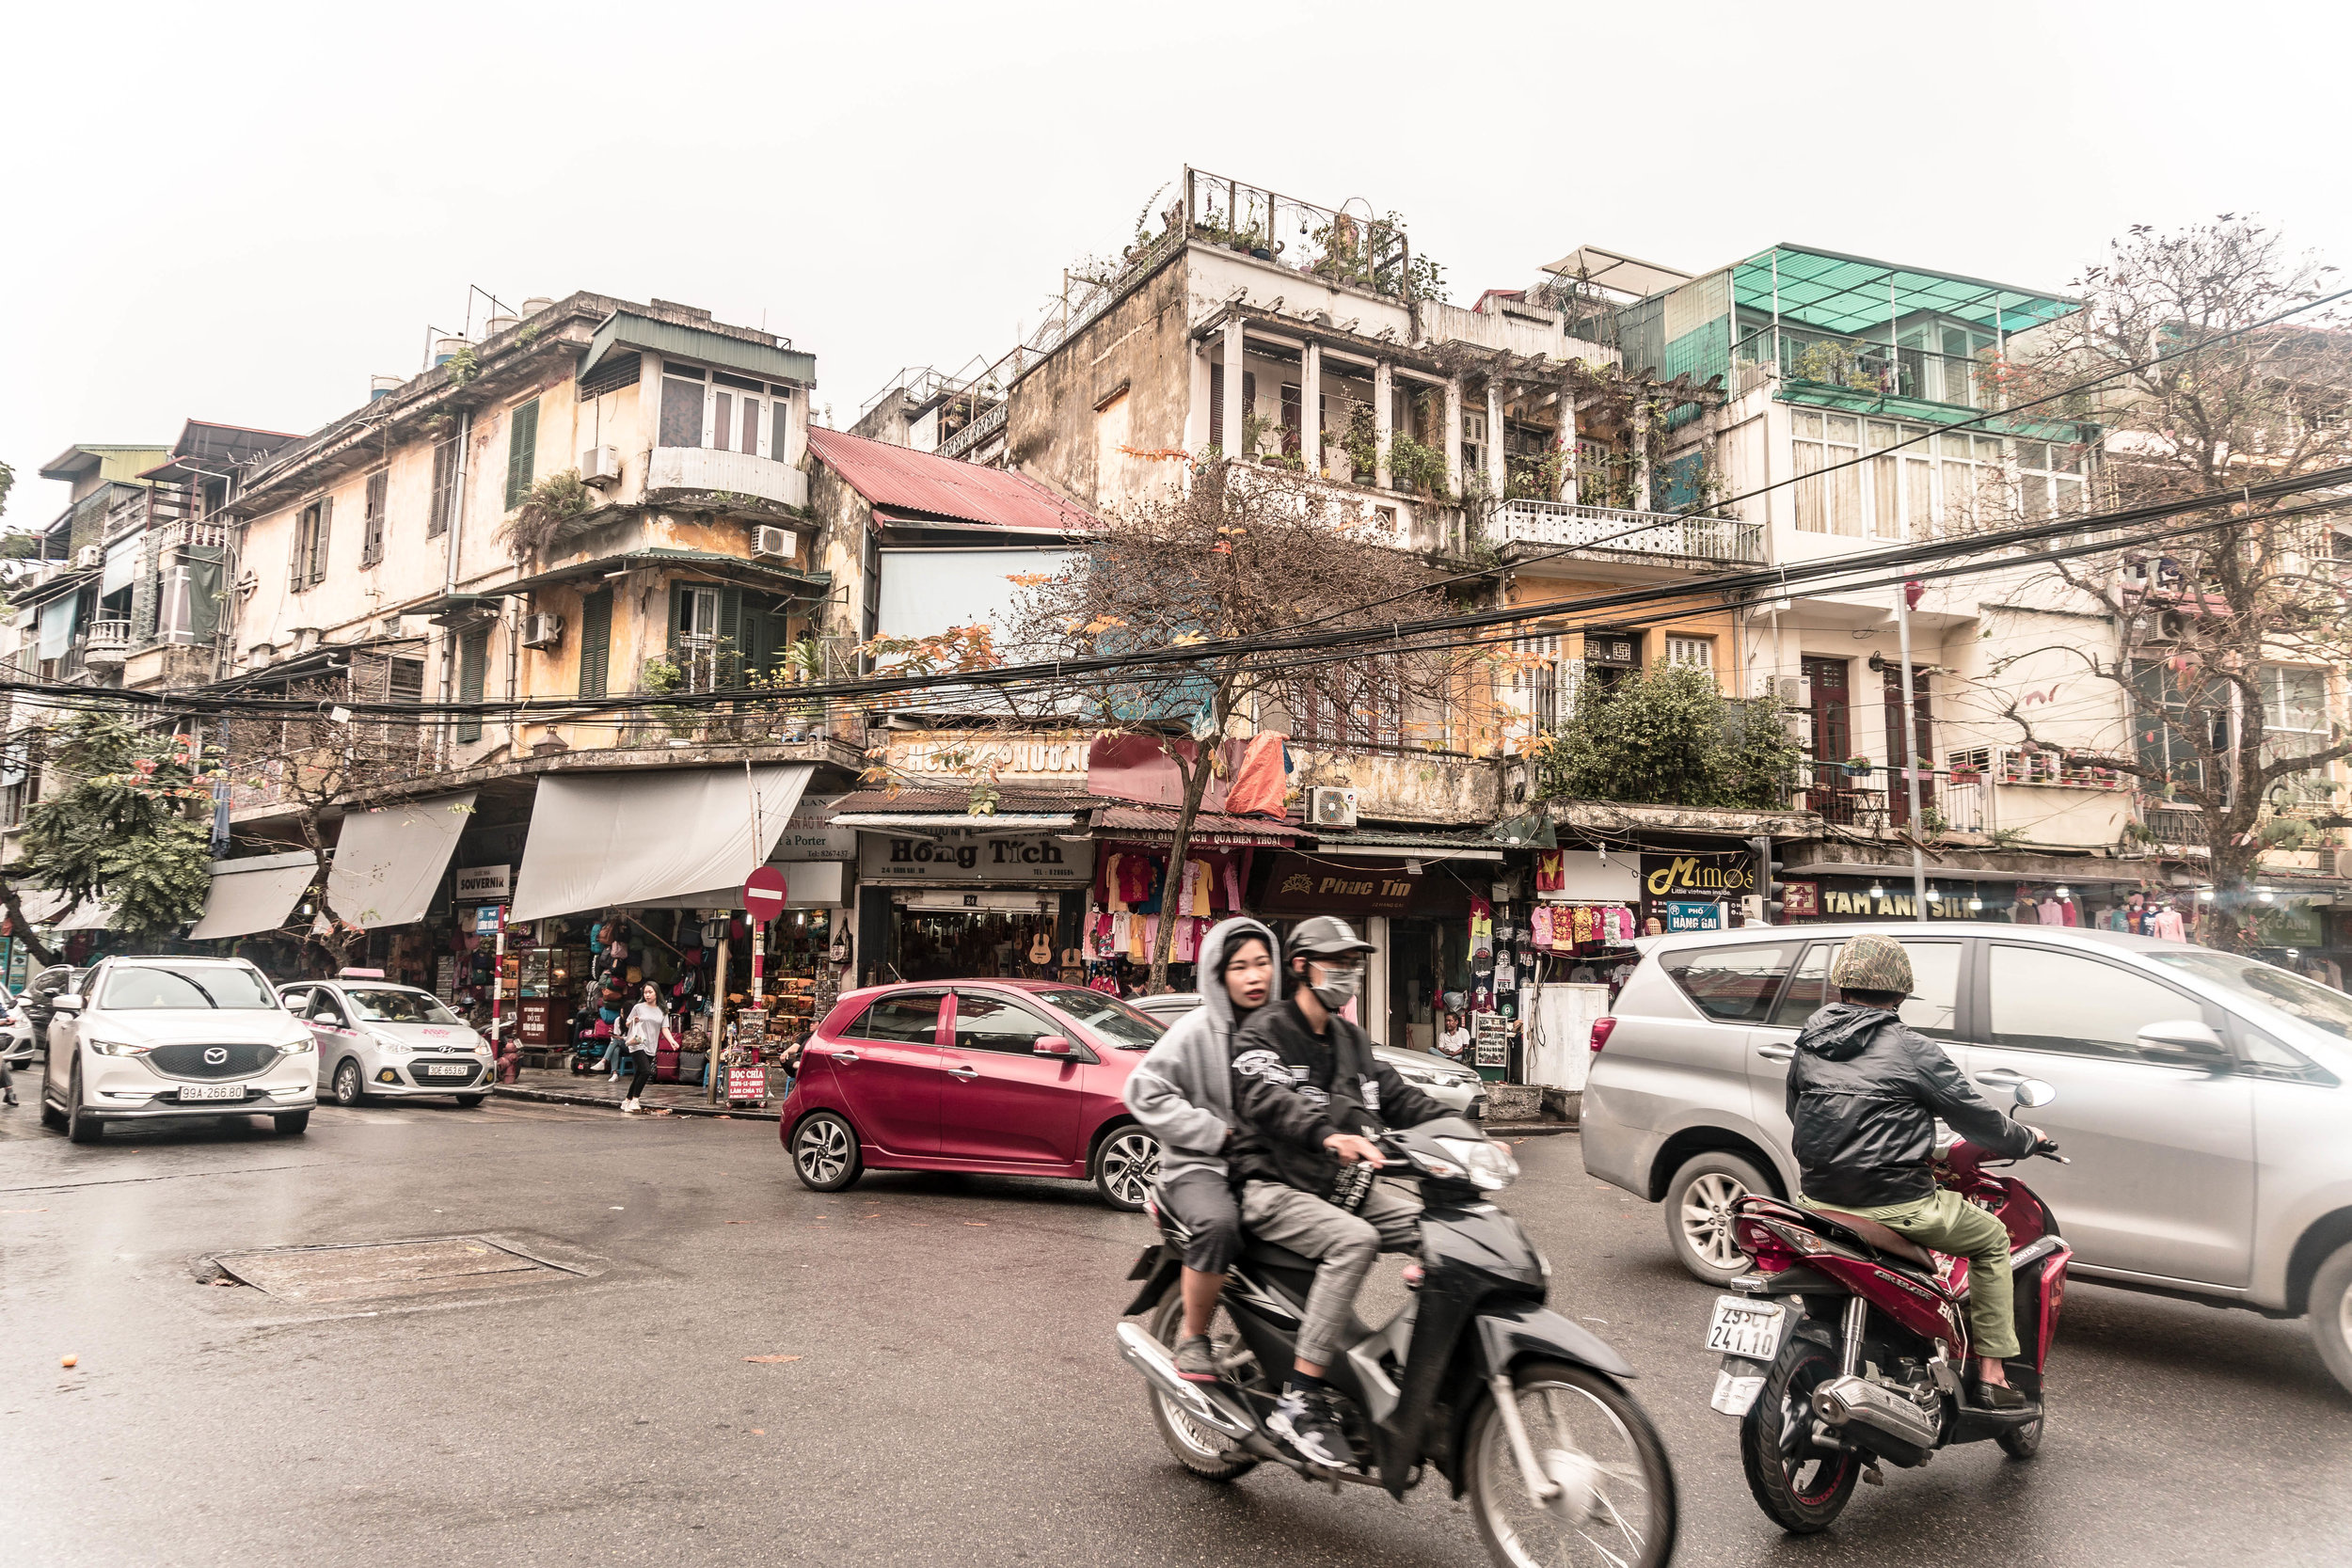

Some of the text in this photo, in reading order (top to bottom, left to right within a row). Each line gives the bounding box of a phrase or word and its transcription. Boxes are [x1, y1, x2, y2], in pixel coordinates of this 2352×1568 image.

[801, 799, 828, 807] LAN
[794, 834, 826, 846] Porter
[1214, 834, 1232, 845] QUA
[1671, 887, 1687, 895] Little
[1824, 892, 1871, 915] TAM
[1688, 906, 1705, 915] PHỐ
[1673, 914, 1717, 930] HÀNG GAI
[731, 1068, 764, 1081] BỌC CHÌA
[183, 1087, 243, 1099] 99A-266.80
[1710, 1325, 1774, 1355] 241.10
